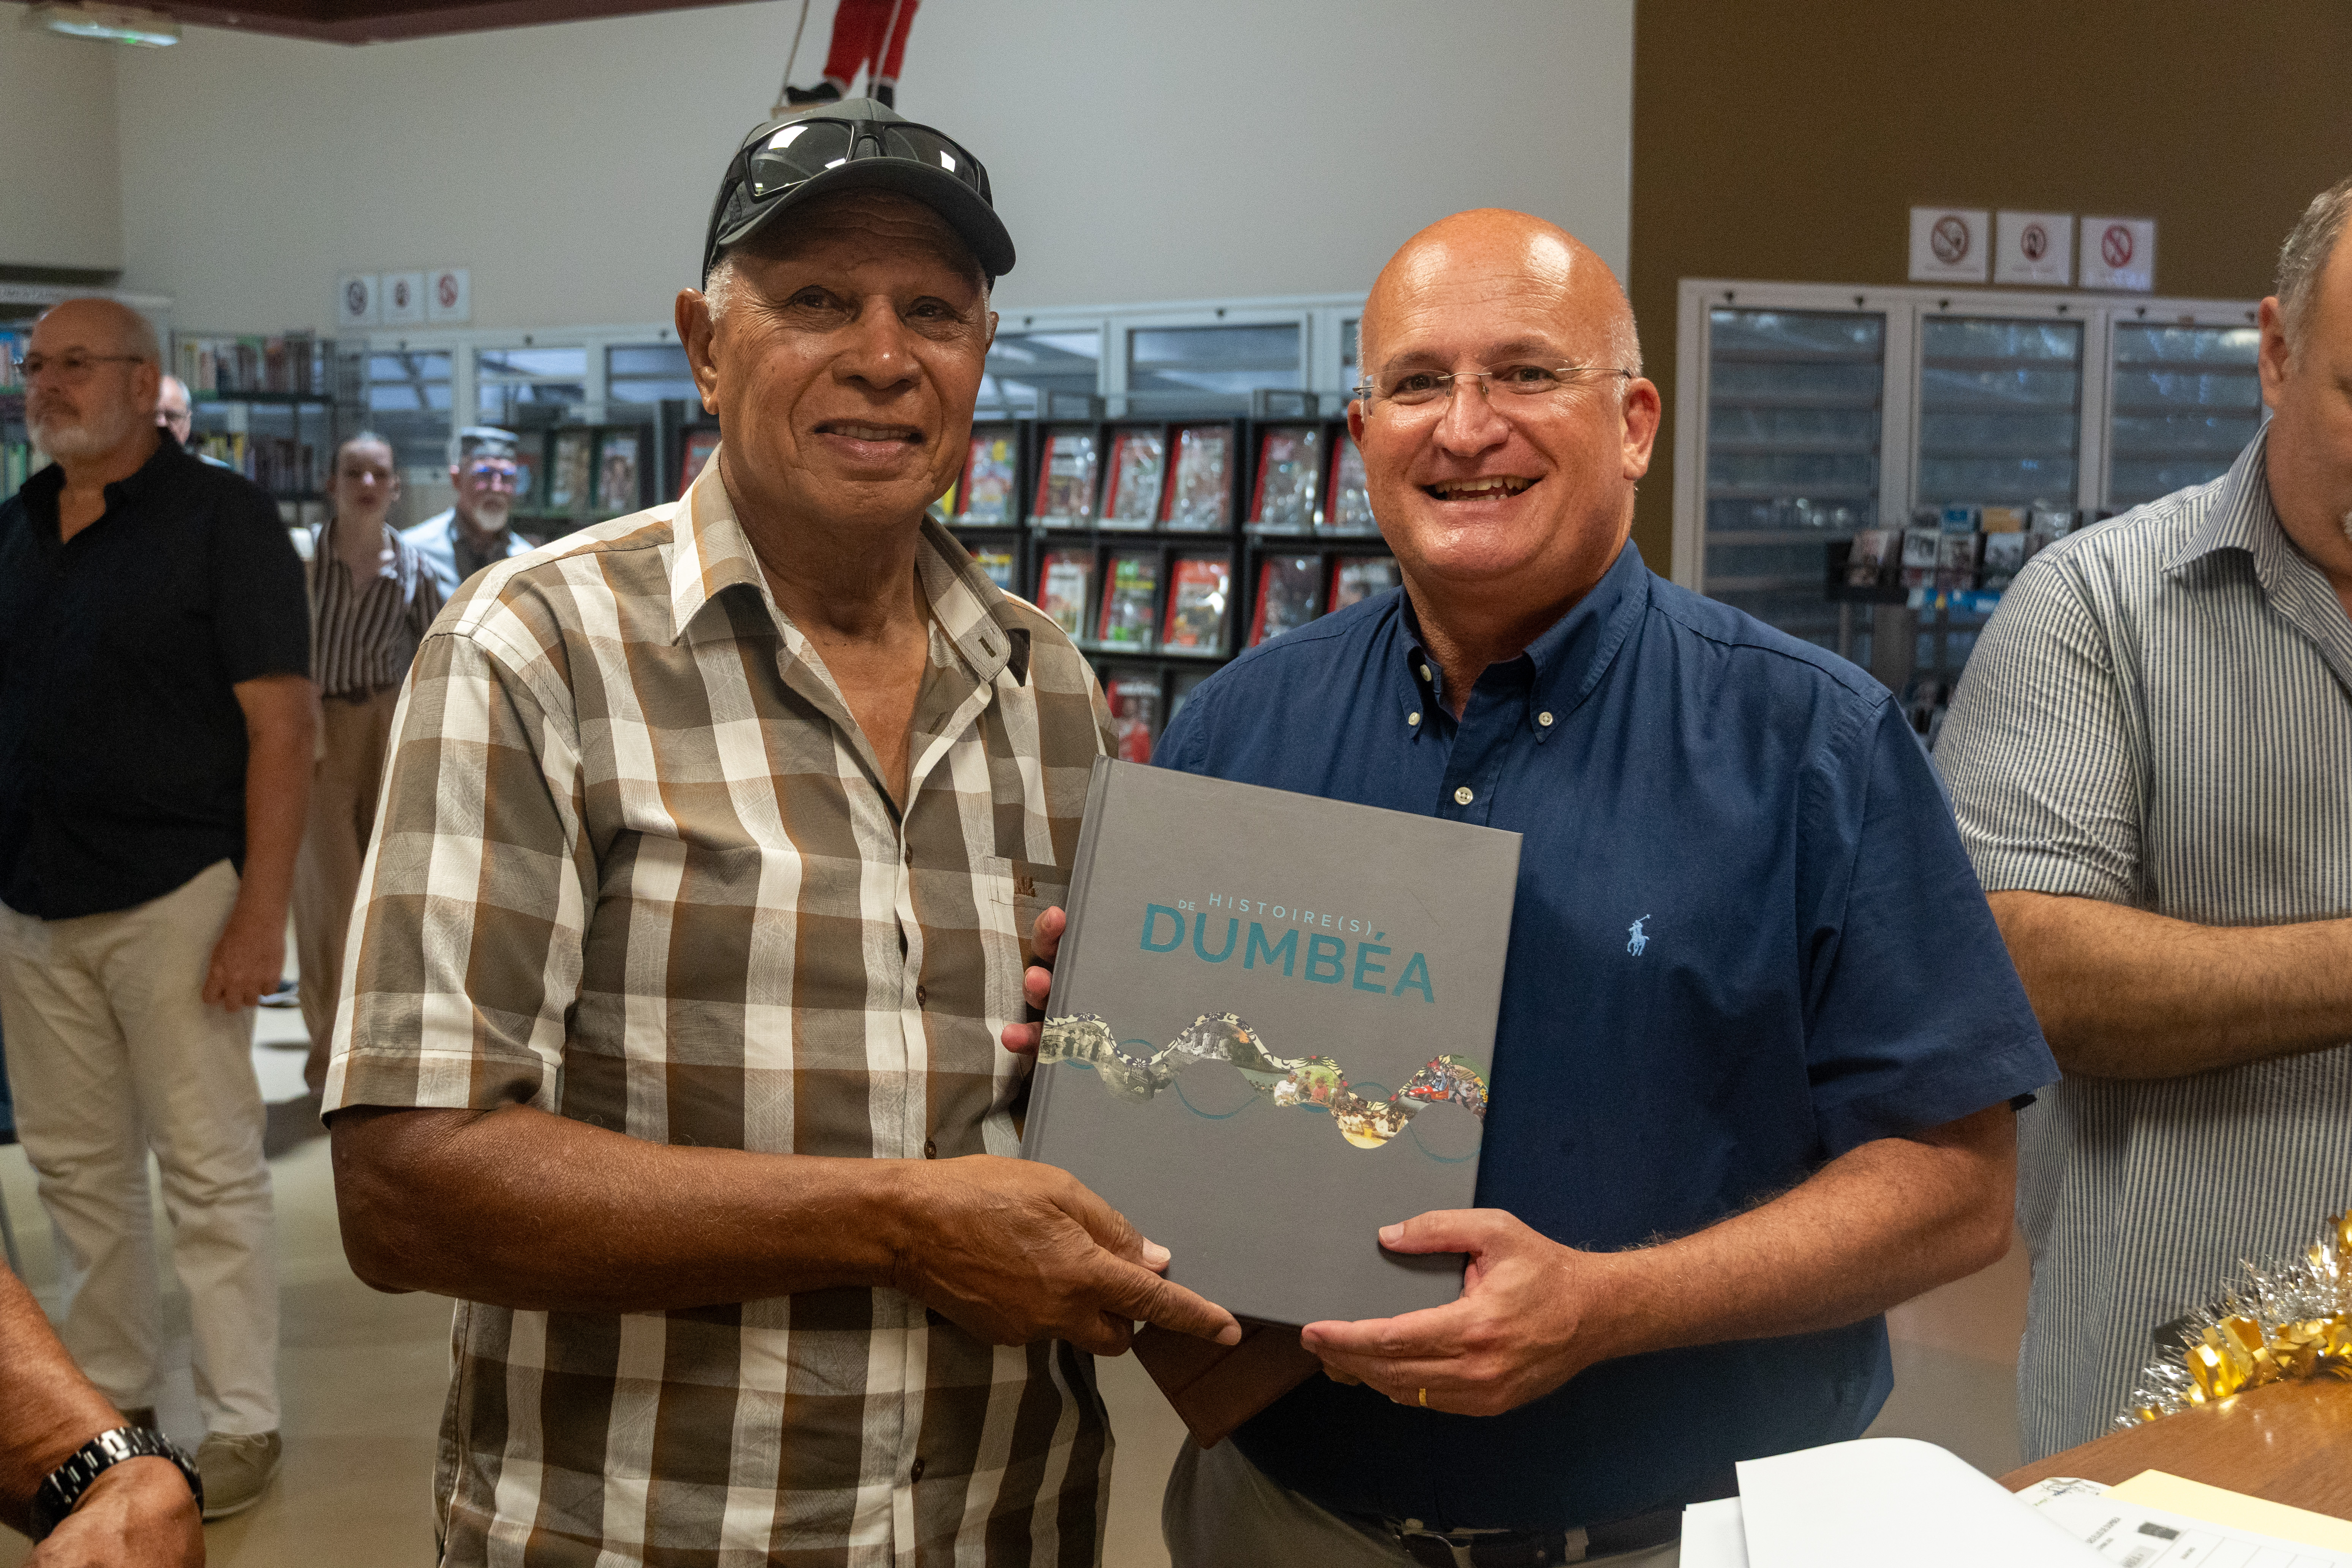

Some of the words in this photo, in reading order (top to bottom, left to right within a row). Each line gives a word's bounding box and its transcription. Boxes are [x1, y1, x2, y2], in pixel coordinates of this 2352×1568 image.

[1178, 899, 1195, 911] DE
[1209, 892, 1372, 936] HISTOIRE(S)
[1139, 903, 1435, 1004] DUMBÉA
